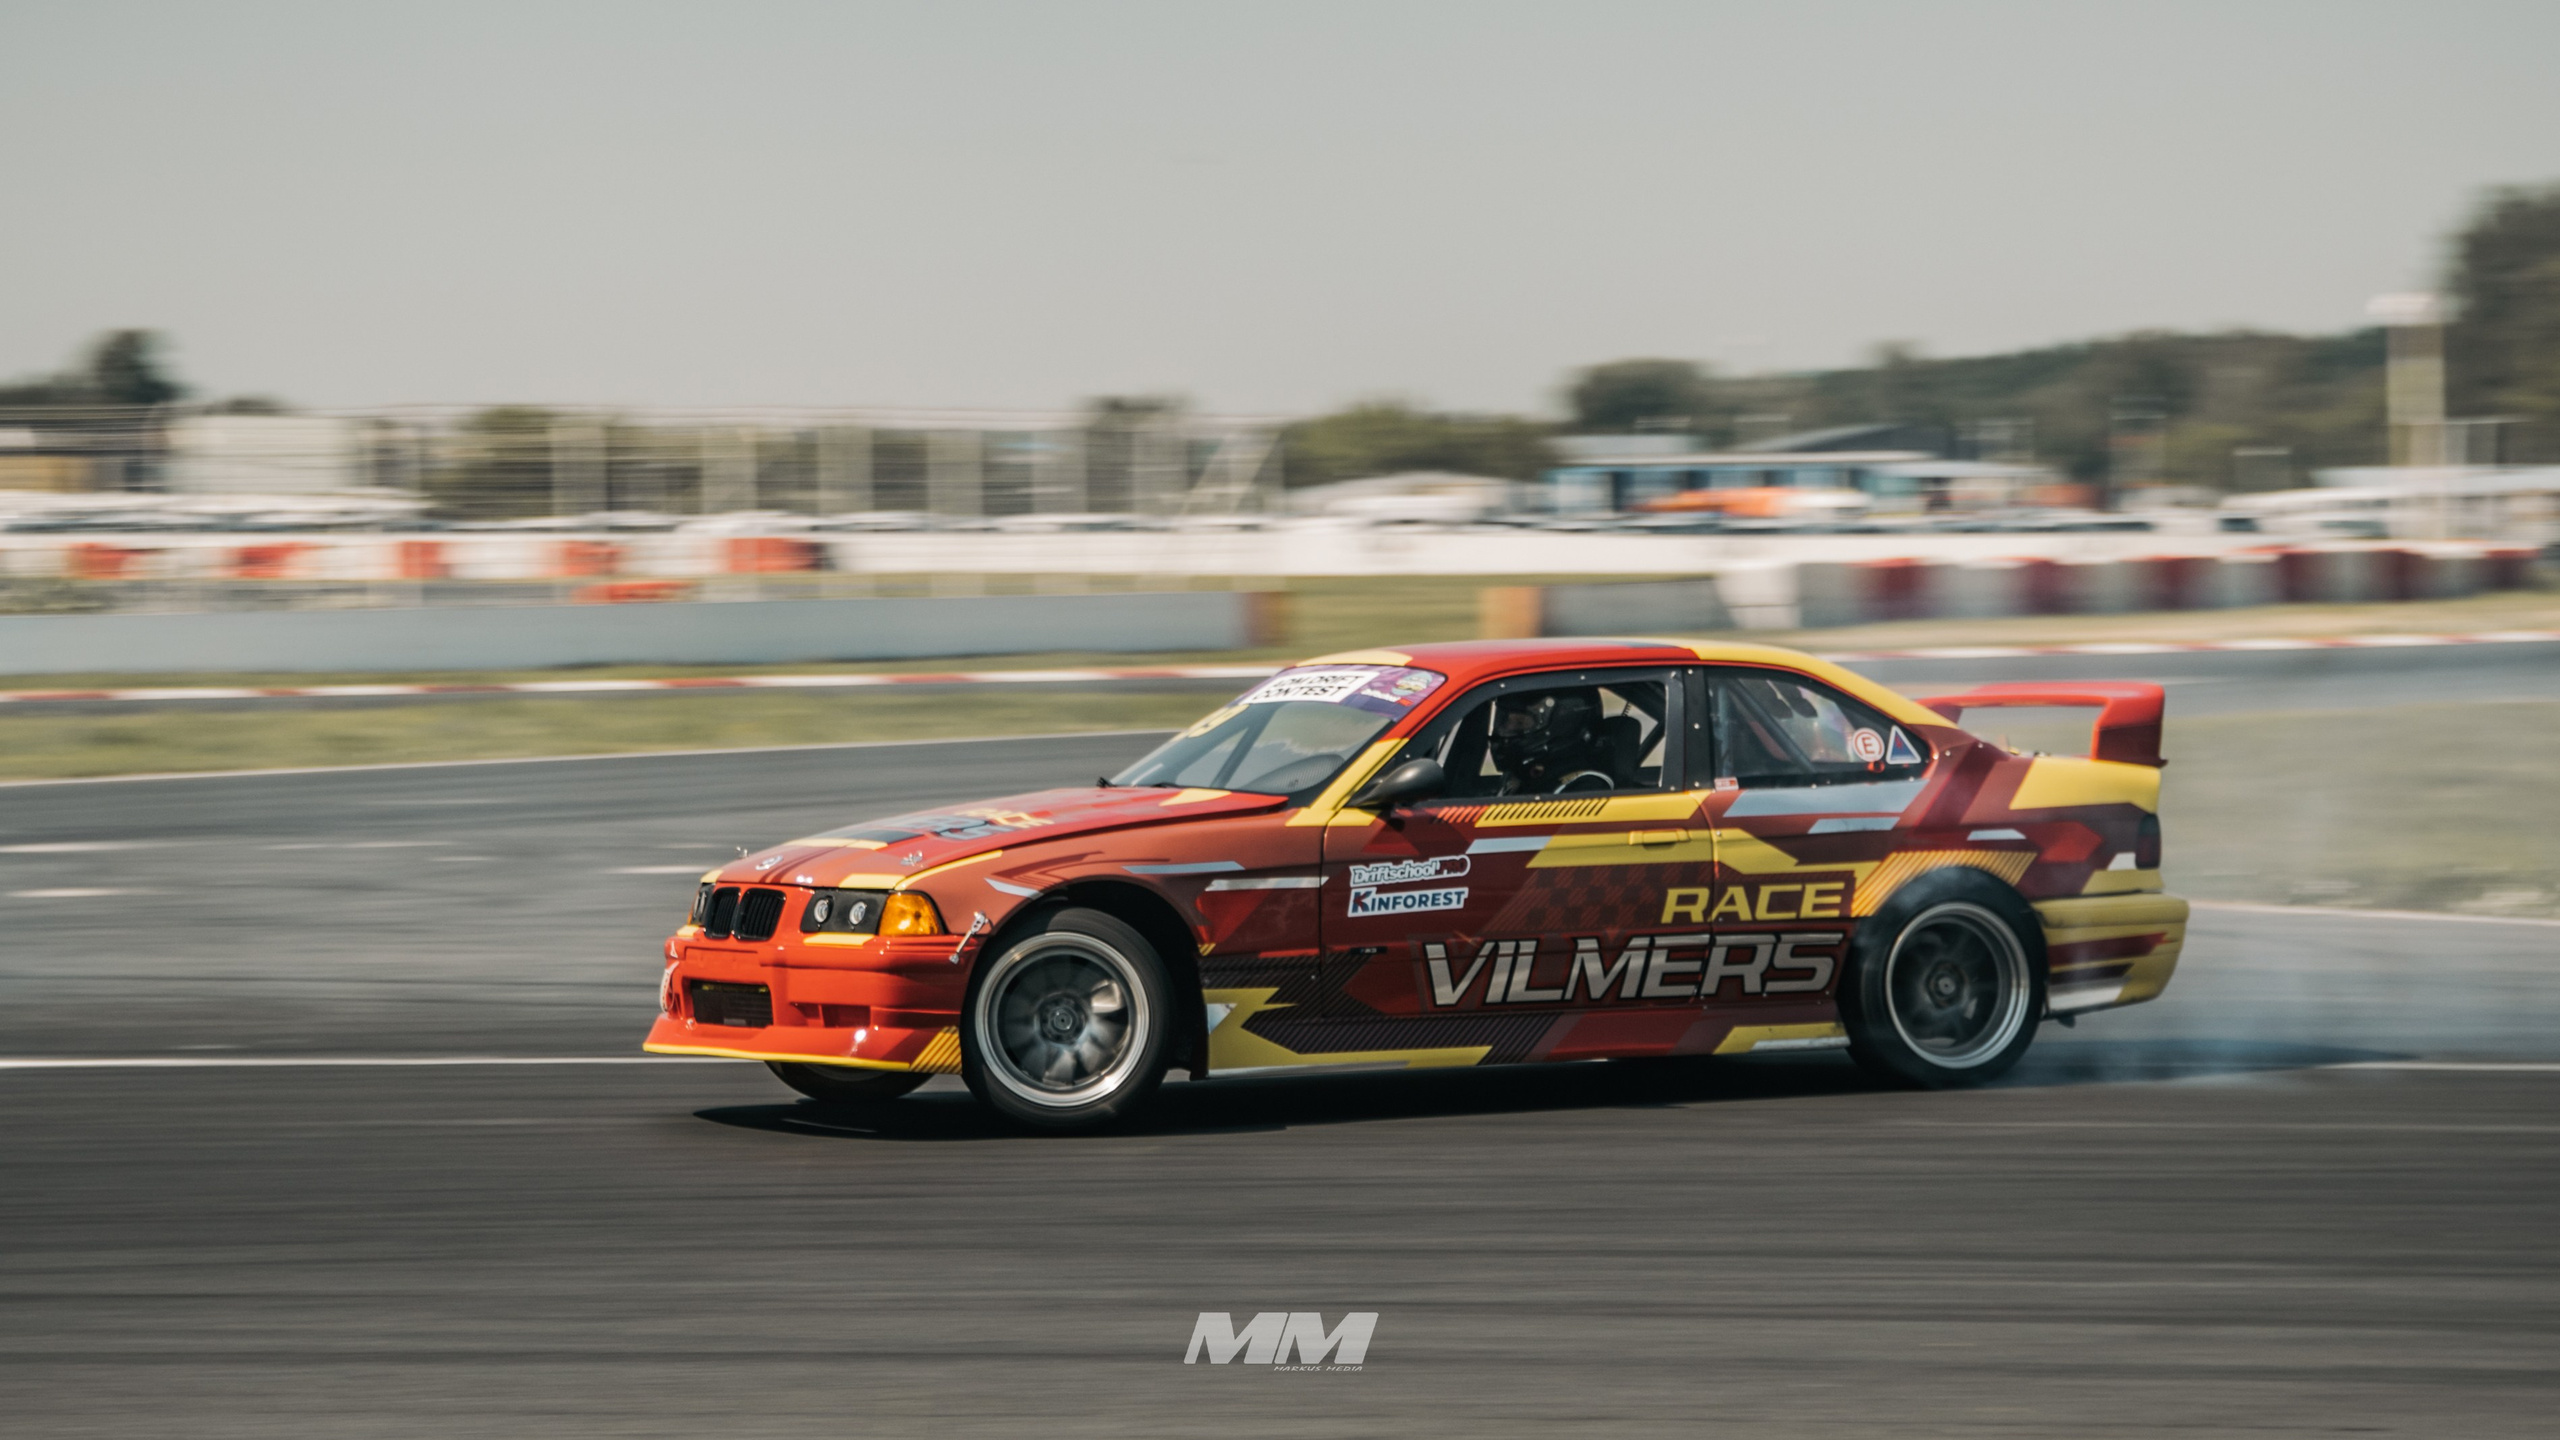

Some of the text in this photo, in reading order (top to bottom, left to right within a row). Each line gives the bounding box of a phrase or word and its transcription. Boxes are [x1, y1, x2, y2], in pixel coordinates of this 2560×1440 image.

[1307, 675, 1365, 685] DRIFT
[1252, 685, 1349, 701] CONTEST
[1861, 736, 1875, 755] E
[1352, 860, 1438, 885] Driftschool
[1351, 890, 1466, 914] KINFOREST
[1660, 882, 1846, 924] RACE
[1423, 932, 1844, 1008] VILMERS
